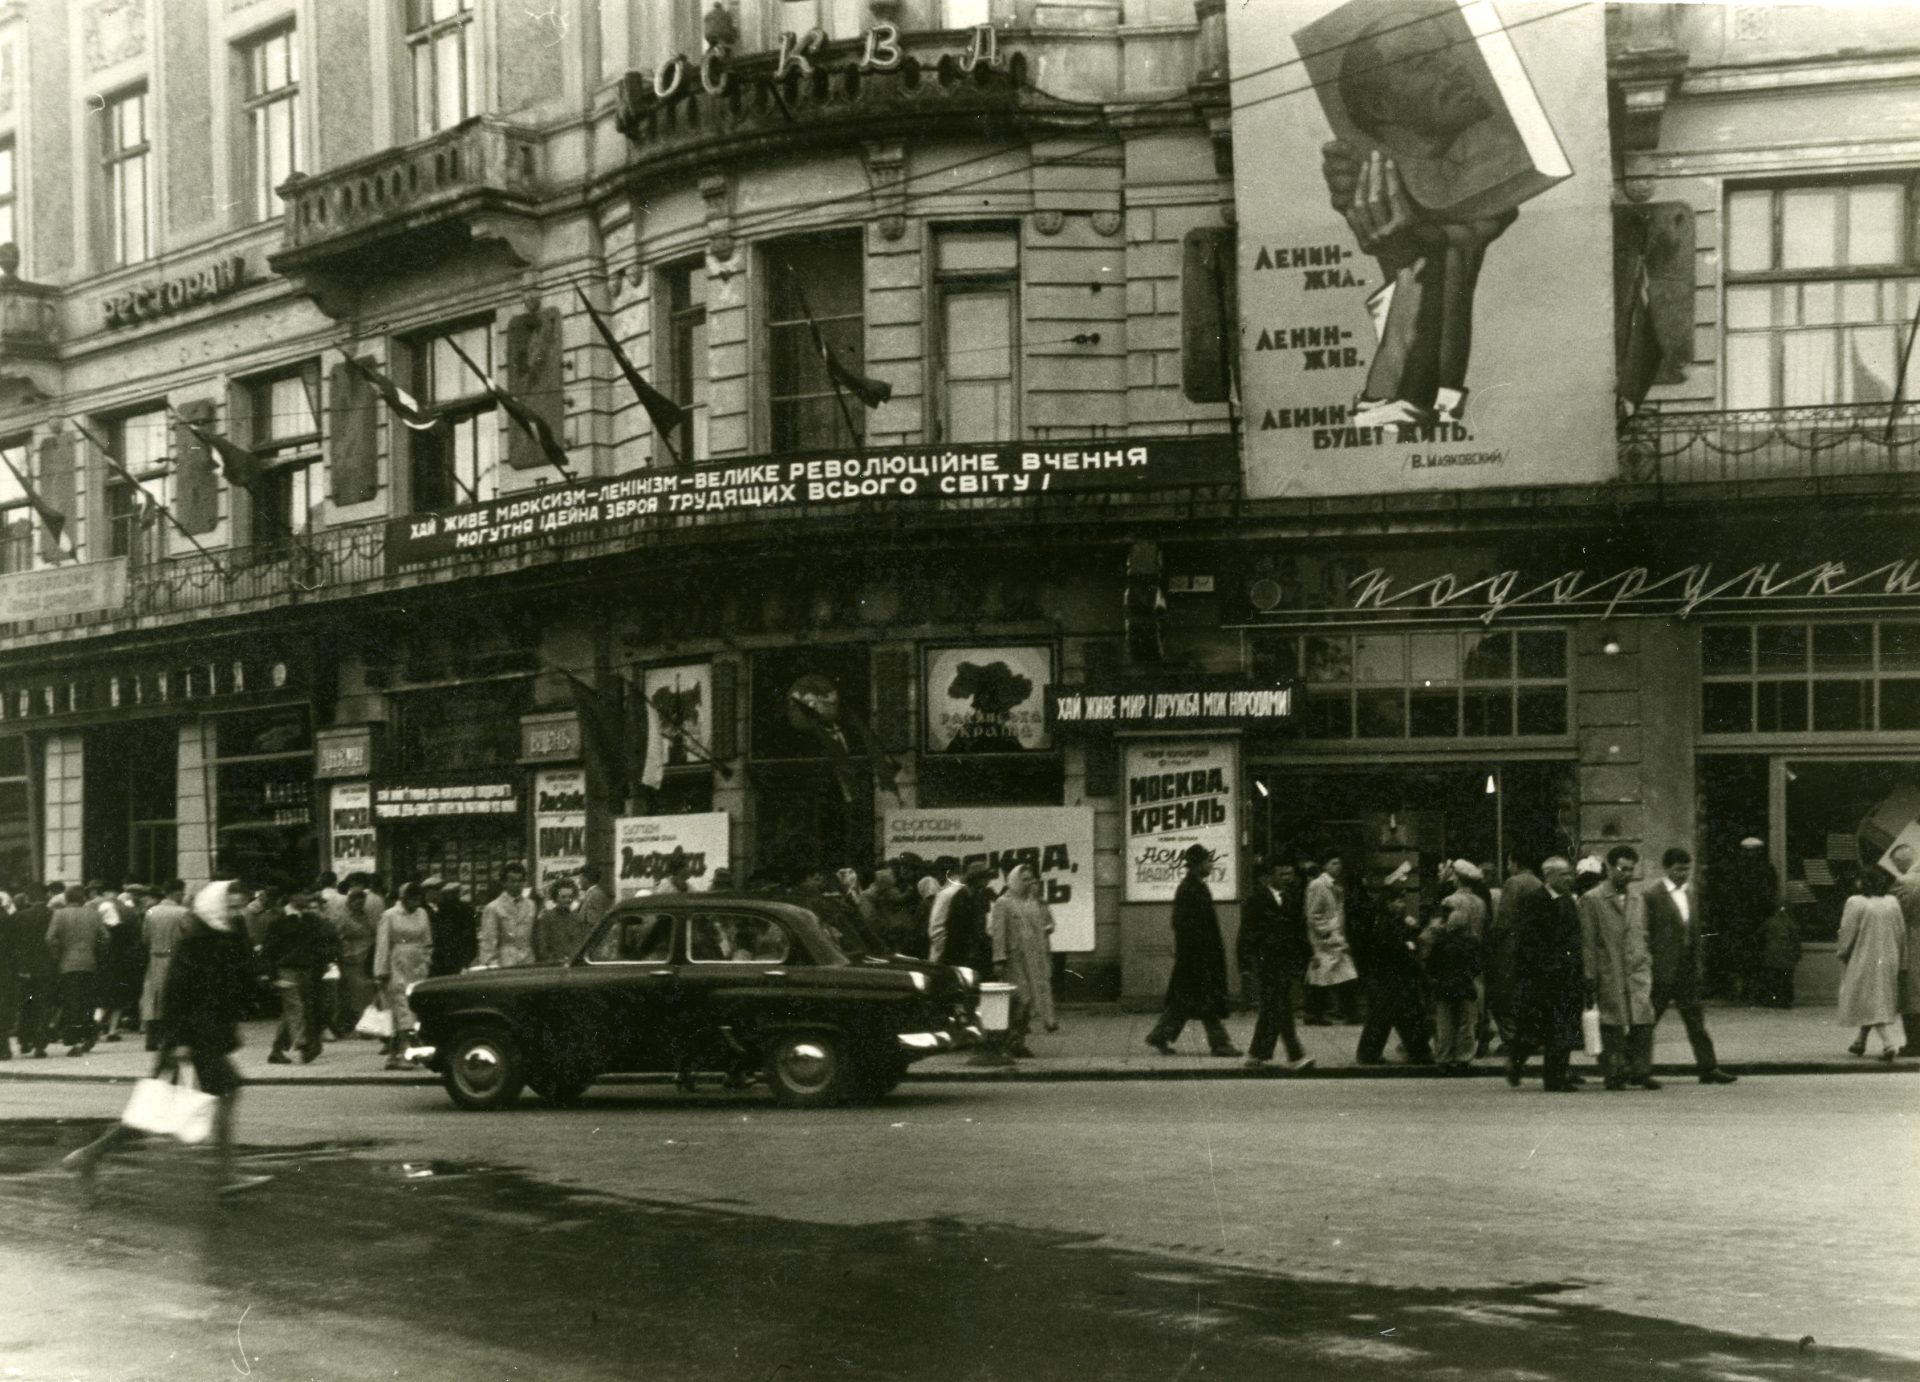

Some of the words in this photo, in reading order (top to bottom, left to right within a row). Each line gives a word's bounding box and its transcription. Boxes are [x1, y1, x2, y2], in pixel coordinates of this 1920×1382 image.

[1254, 245, 1352, 271] ЛЕНИН-
[103, 256, 246, 327] РЕСТОРАН
[1304, 269, 1365, 290] ЖИЛ.
[1255, 325, 1352, 351] ЛЕНИН-
[1304, 348, 1365, 370] ЖИВ.
[1313, 424, 1385, 449] БУДЕТ
[1396, 421, 1474, 444] ЖИТЬ.
[410, 518, 436, 540] ХАЙ
[444, 509, 489, 532] ЖИВЕ
[789, 452, 999, 481] РЕВОЛЮЦІЙНЕ
[1021, 448, 1148, 470] ВЧЕННЯ
[456, 520, 533, 548] МОГУТНЯ
[540, 503, 599, 532] ІДЕЙНА
[605, 497, 658, 520] ЗБРОЯ
[669, 483, 796, 512] ТРУДЯЩИХ
[808, 476, 917, 500] ВСЬОГО
[1057, 693, 1081, 720] ХАЙ
[1085, 695, 1117, 720] ЖИВЕ
[1120, 694, 1146, 719] МИР
[1154, 692, 1200, 719] ДРУЖБА
[1130, 767, 1230, 805] МОСКВА,
[1131, 798, 1226, 835] КРЕМЛЬ
